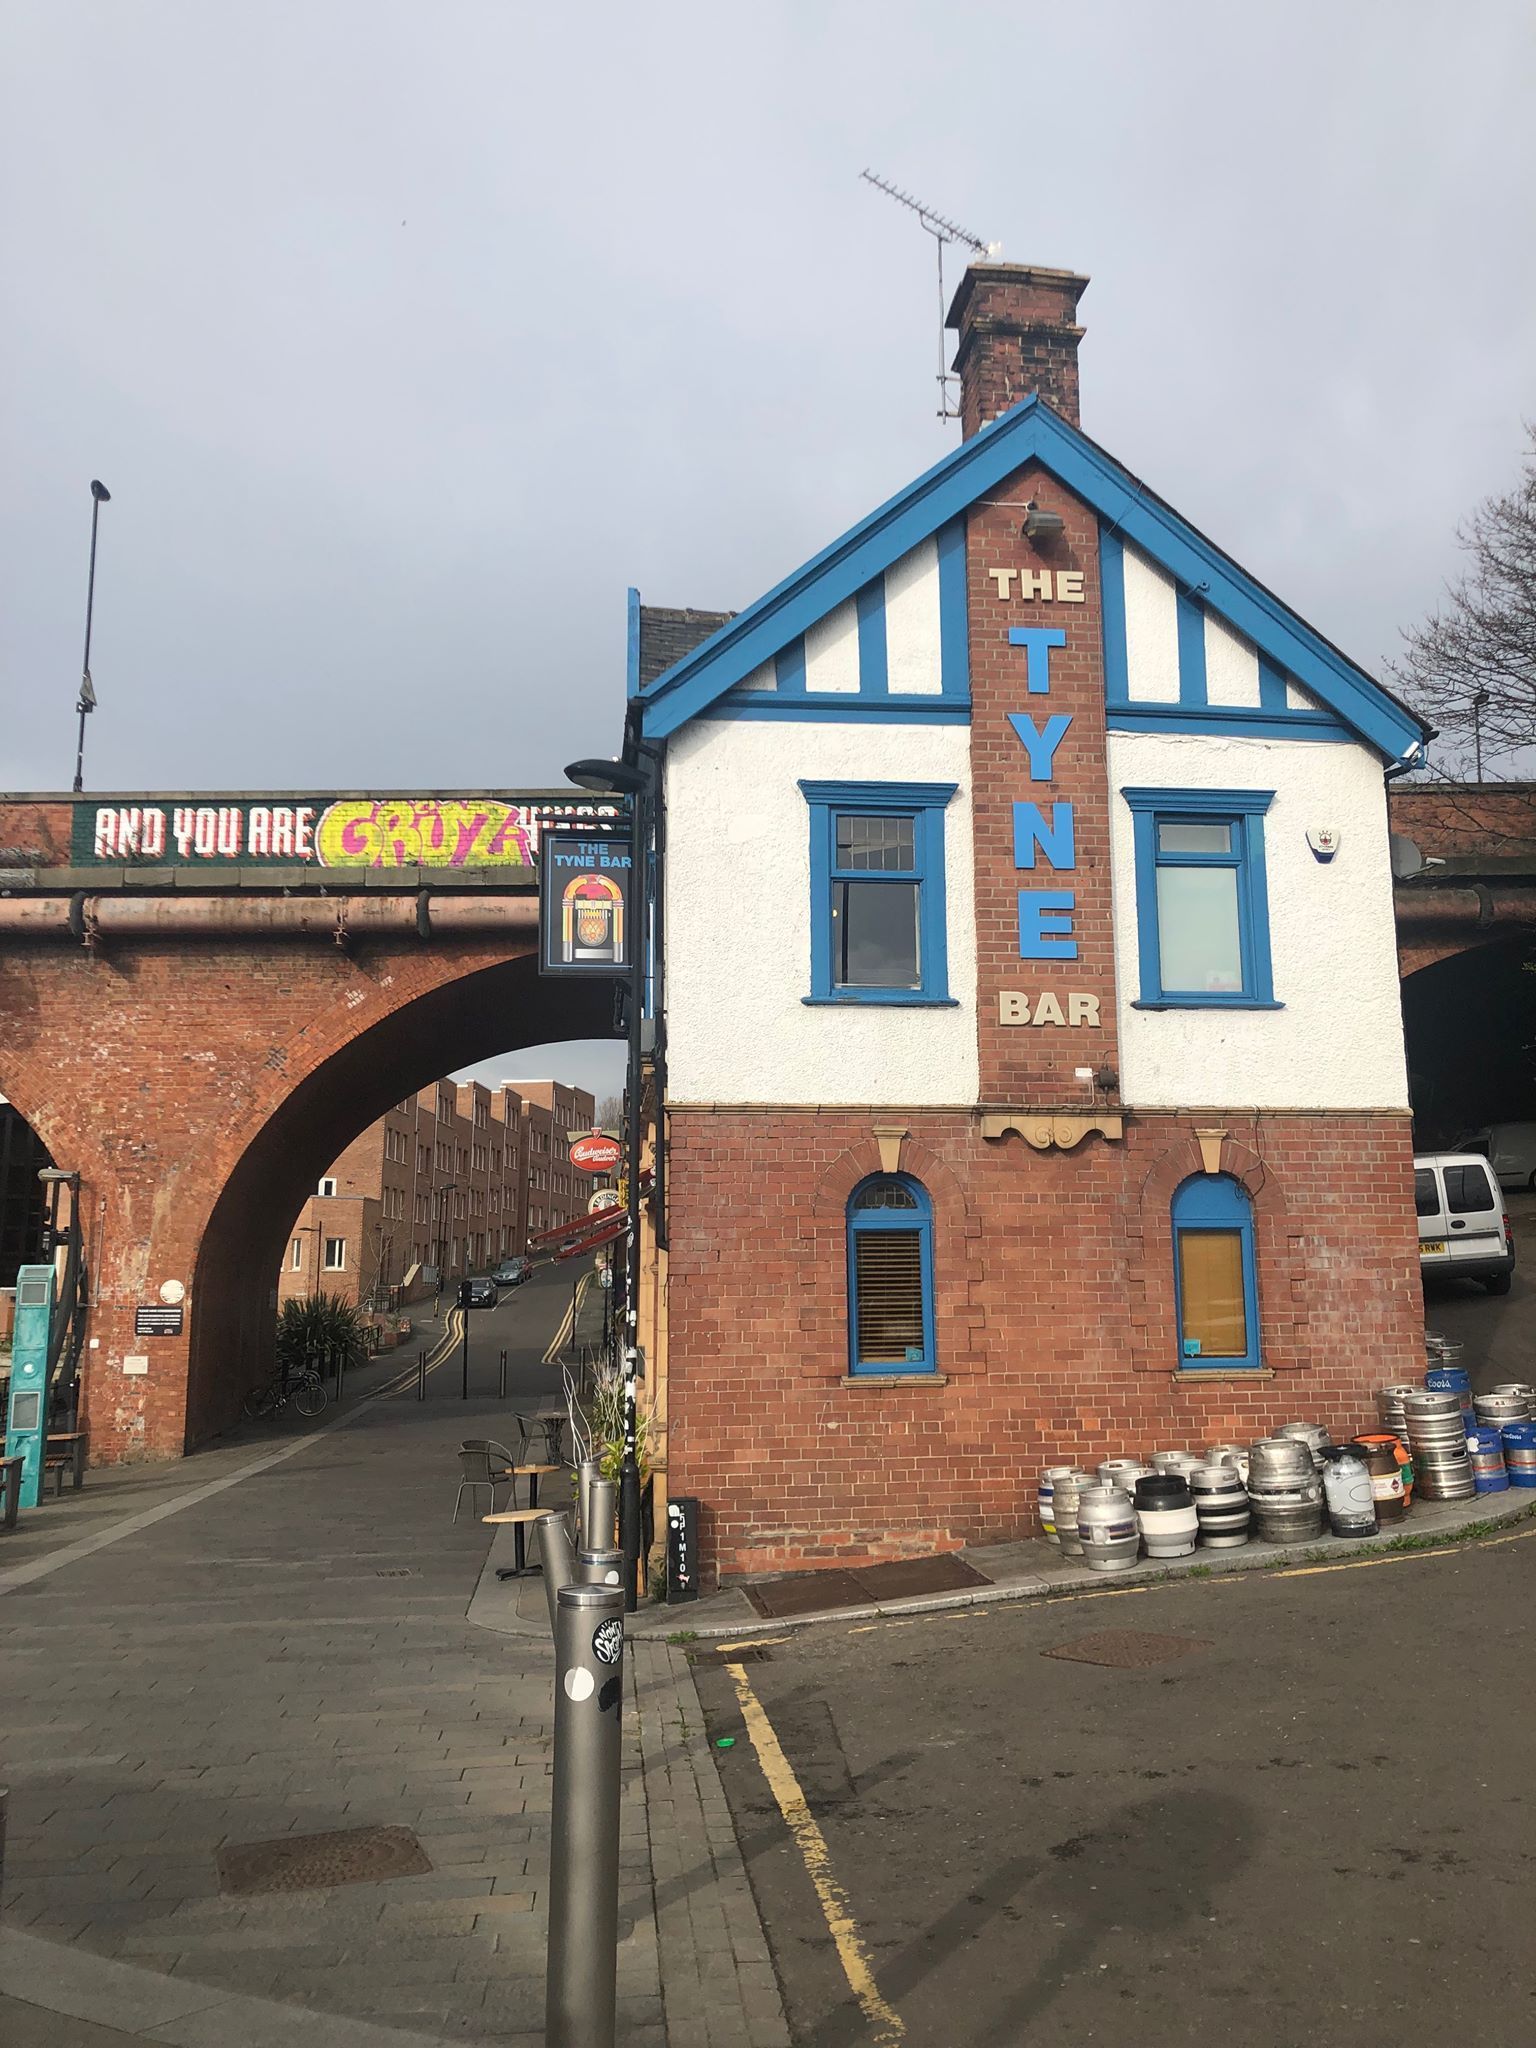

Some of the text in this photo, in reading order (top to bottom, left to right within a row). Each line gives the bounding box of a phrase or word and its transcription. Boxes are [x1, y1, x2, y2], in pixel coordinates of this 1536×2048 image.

[989, 568, 1085, 603] THE
[1007, 626, 1079, 959] TYNE
[95, 806, 315, 858] AND YOU ARE
[578, 843, 609, 855] THE
[554, 855, 632, 868] TYNE BAR
[999, 991, 1102, 1028] BAR
